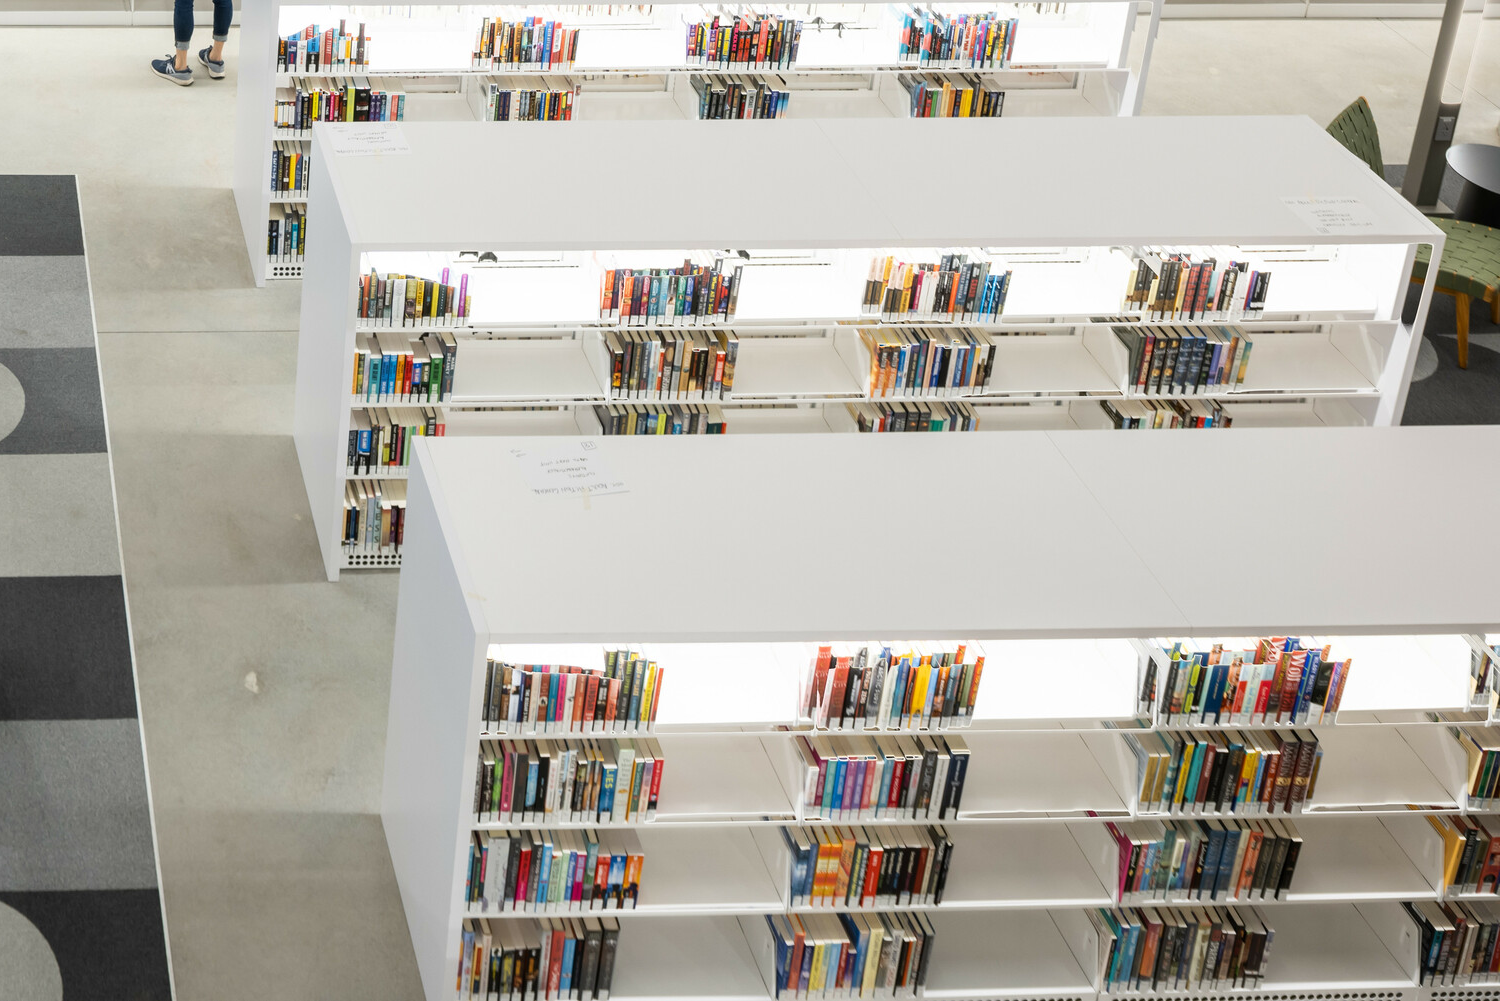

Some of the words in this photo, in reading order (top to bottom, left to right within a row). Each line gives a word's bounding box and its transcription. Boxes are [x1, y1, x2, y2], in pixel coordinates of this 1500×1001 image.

[1286, 654, 1305, 682] Wolf
[1281, 690, 1298, 713] Hall
[1280, 745, 1296, 777] MARTIN
[1298, 744, 1314, 777] MARTIN
[605, 768, 615, 789] LIES
